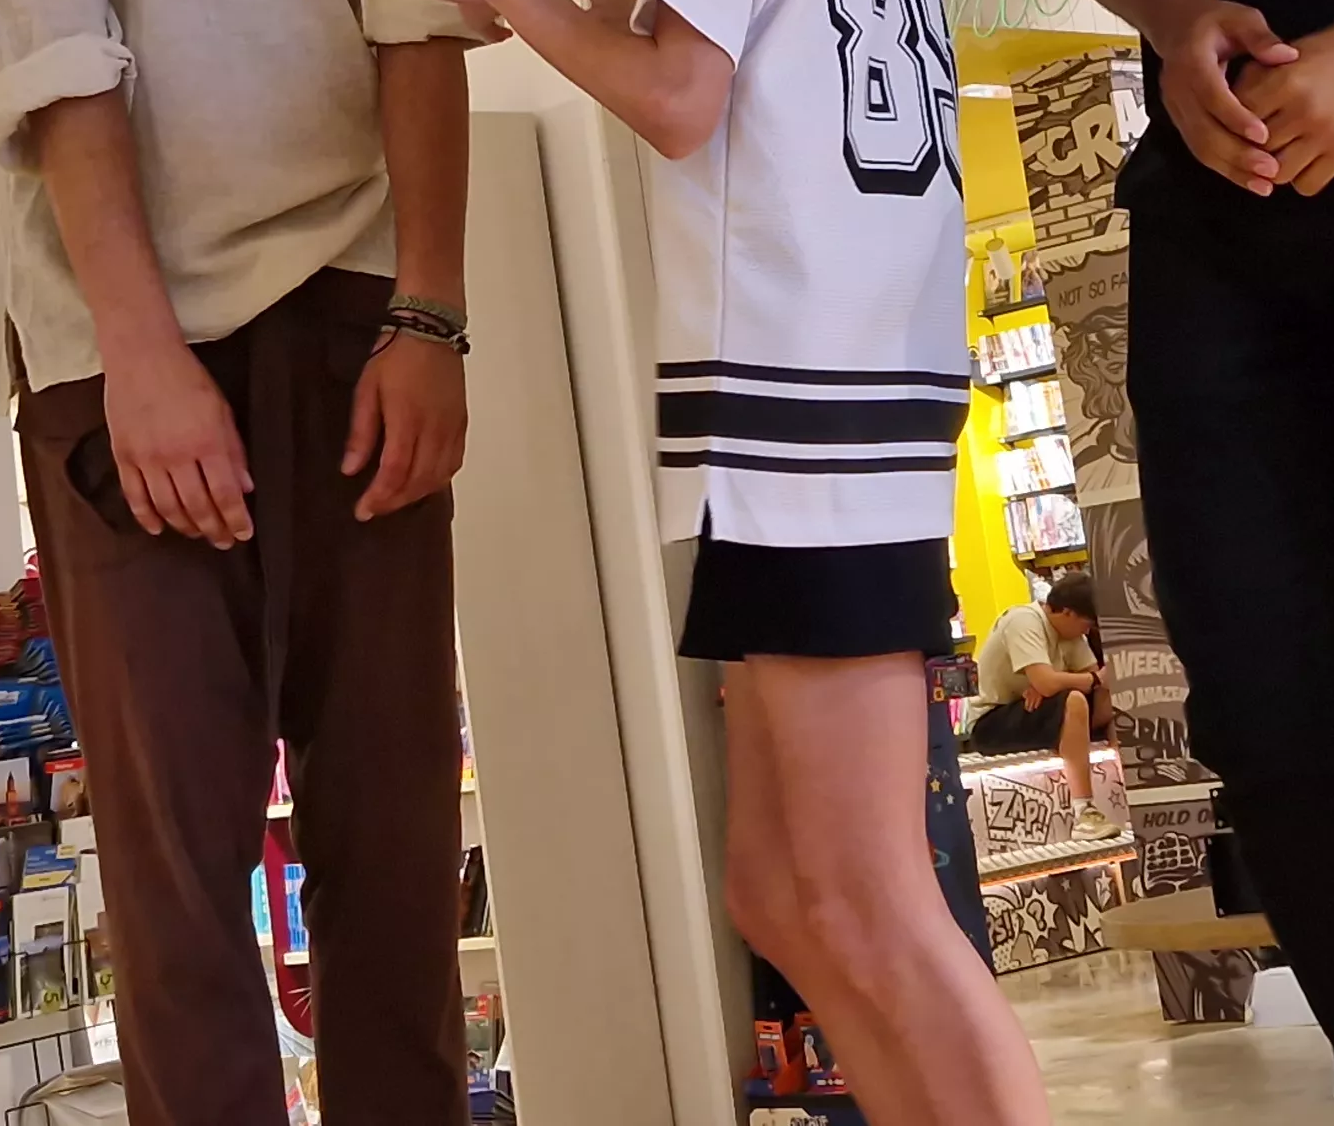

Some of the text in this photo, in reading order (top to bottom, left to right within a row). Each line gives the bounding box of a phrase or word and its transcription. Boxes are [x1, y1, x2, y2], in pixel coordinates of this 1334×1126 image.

[1058, 285, 1083, 309] NOT
[1088, 279, 1106, 299] SO
[988, 788, 1048, 835] ZAP!
[1143, 809, 1190, 828] HOLD
